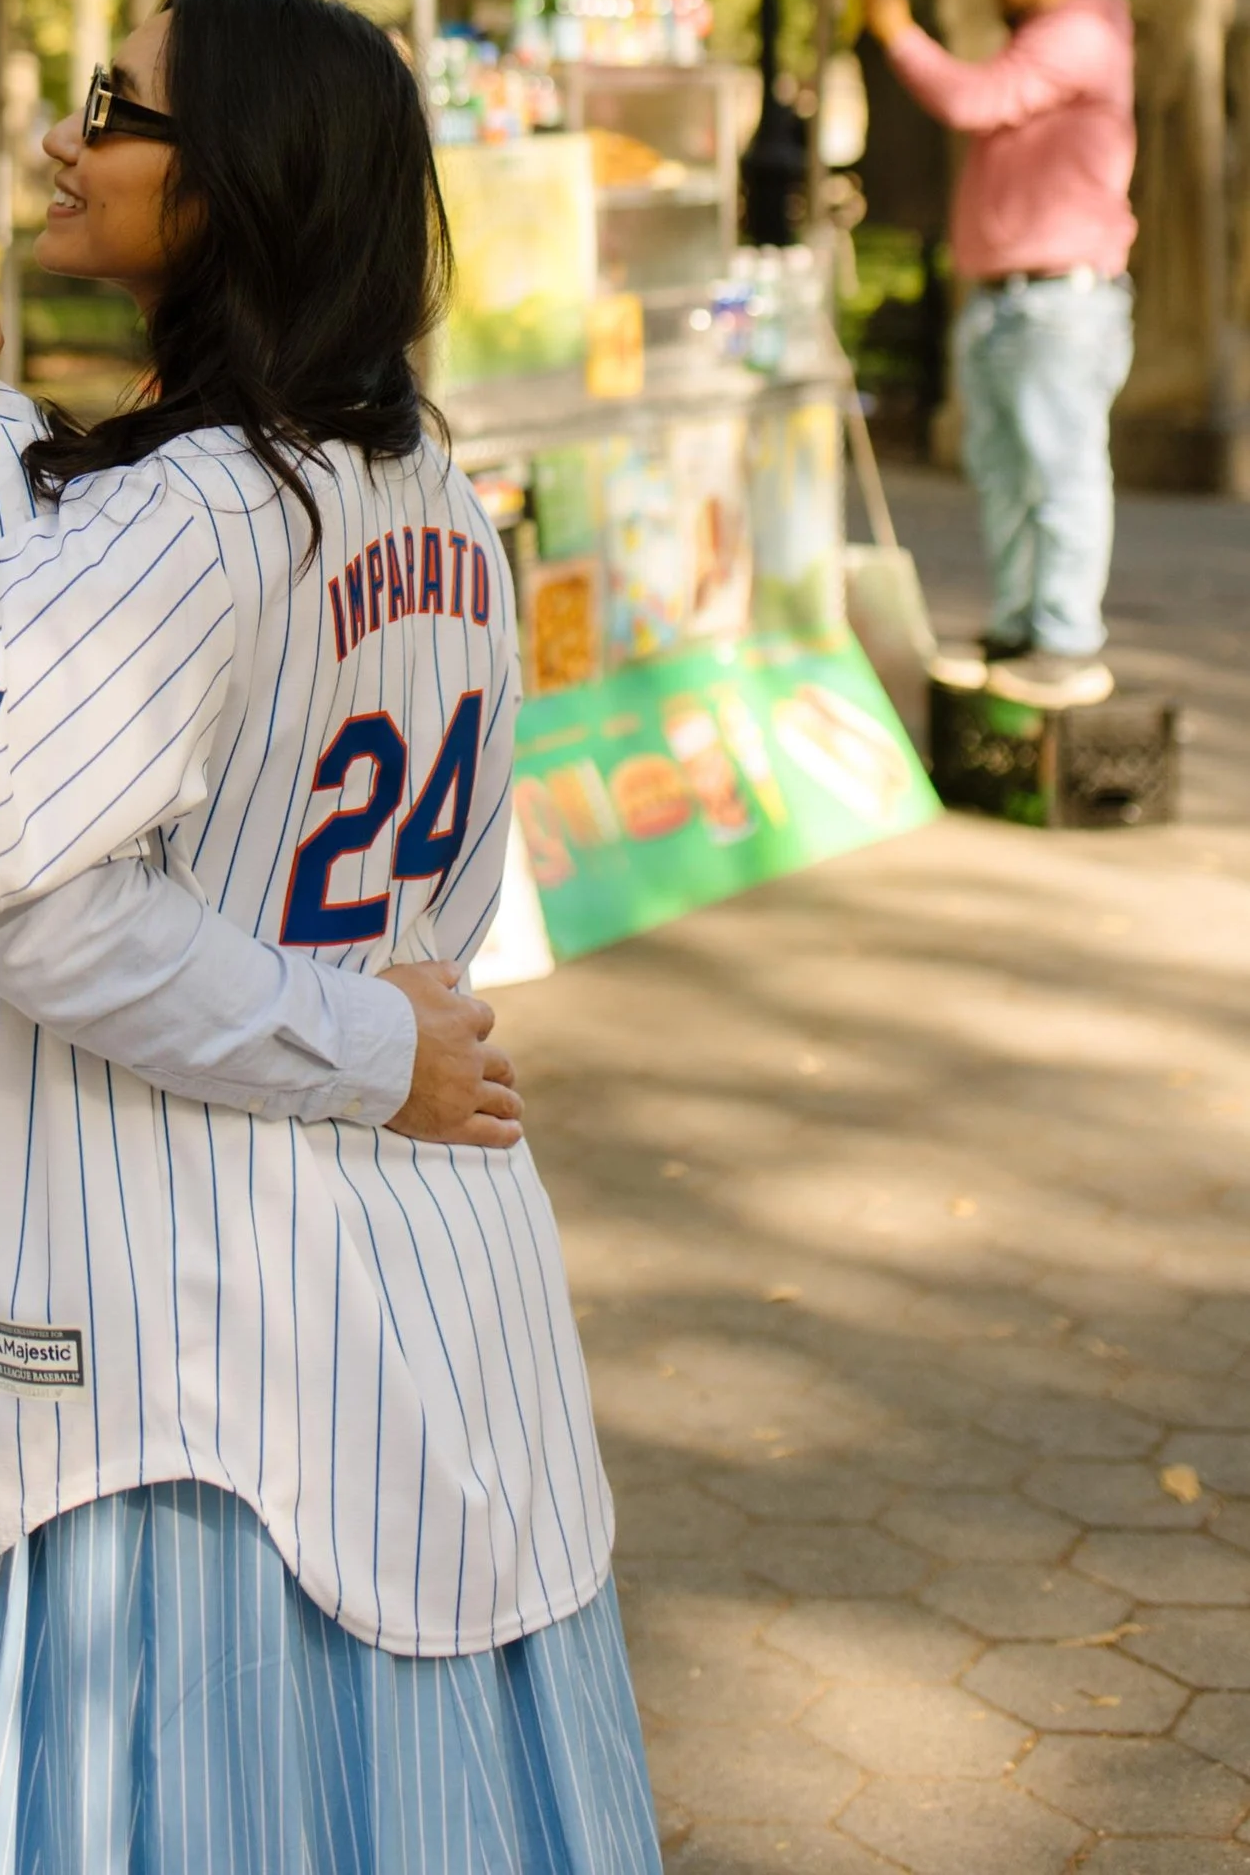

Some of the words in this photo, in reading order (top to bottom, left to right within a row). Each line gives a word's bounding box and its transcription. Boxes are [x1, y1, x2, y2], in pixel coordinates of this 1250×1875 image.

[328, 525, 490, 664] IMPARATO
[279, 688, 484, 947] 24
[3, 1337, 71, 1365] Majestic
[3, 1365, 31, 1381] LEAGUE
